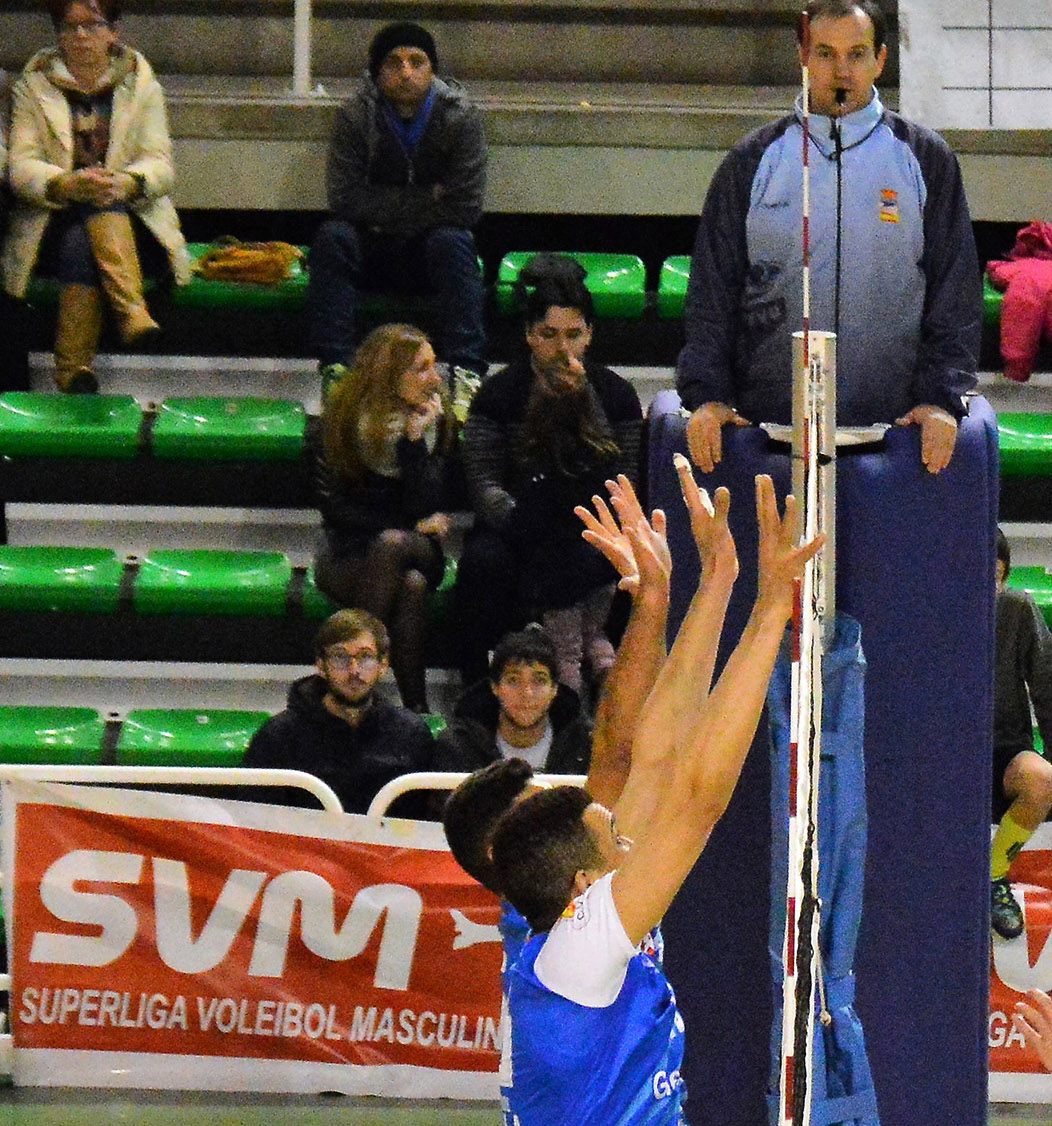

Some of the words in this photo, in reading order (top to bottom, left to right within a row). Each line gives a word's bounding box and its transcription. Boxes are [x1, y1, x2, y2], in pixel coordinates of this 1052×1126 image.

[29, 849, 423, 991] SVM
[19, 987, 189, 1031] SUPERLIGA
[197, 997, 341, 1041] VOLEIBOL
